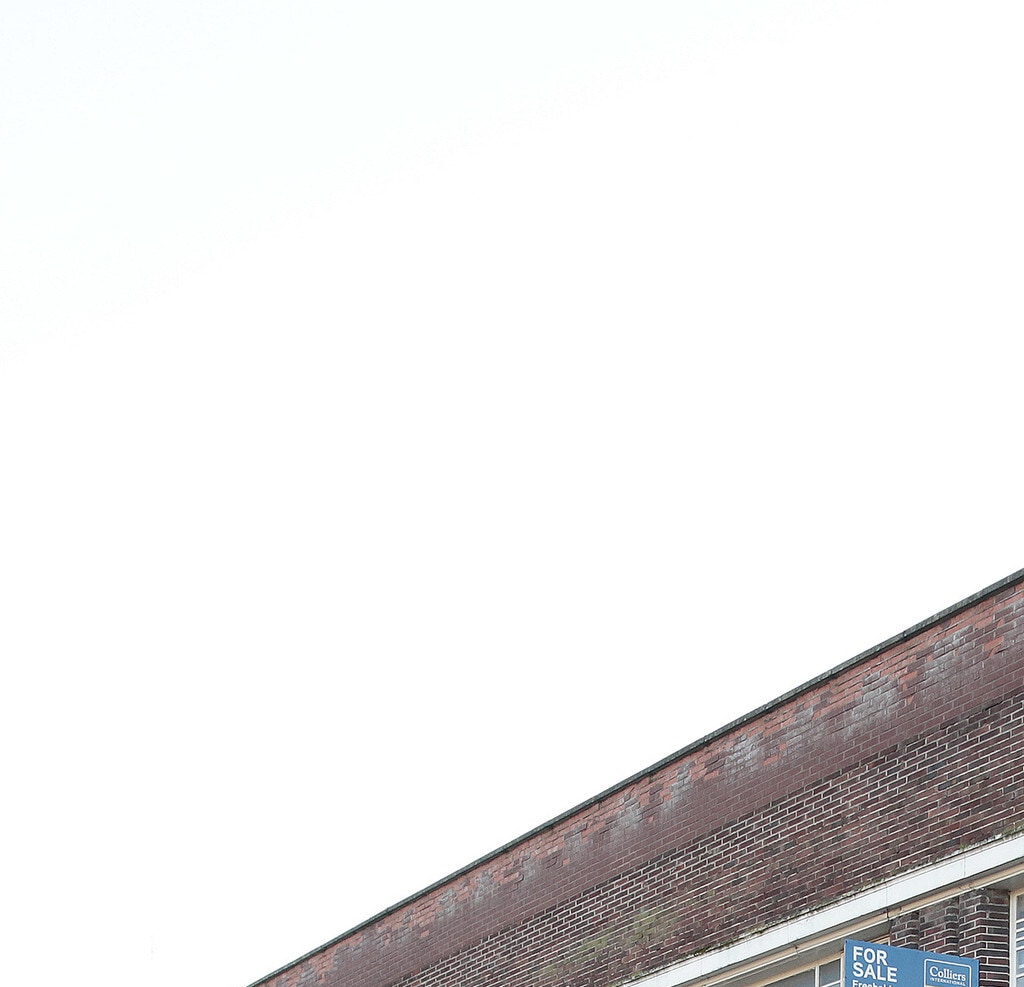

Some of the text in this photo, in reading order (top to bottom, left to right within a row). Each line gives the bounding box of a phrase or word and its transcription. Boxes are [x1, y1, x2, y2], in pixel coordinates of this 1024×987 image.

[853, 946, 888, 966] FOR
[853, 962, 898, 983] SALE
[929, 966, 967, 981] Colliers
[930, 977, 967, 987] INTERNATIONAL
